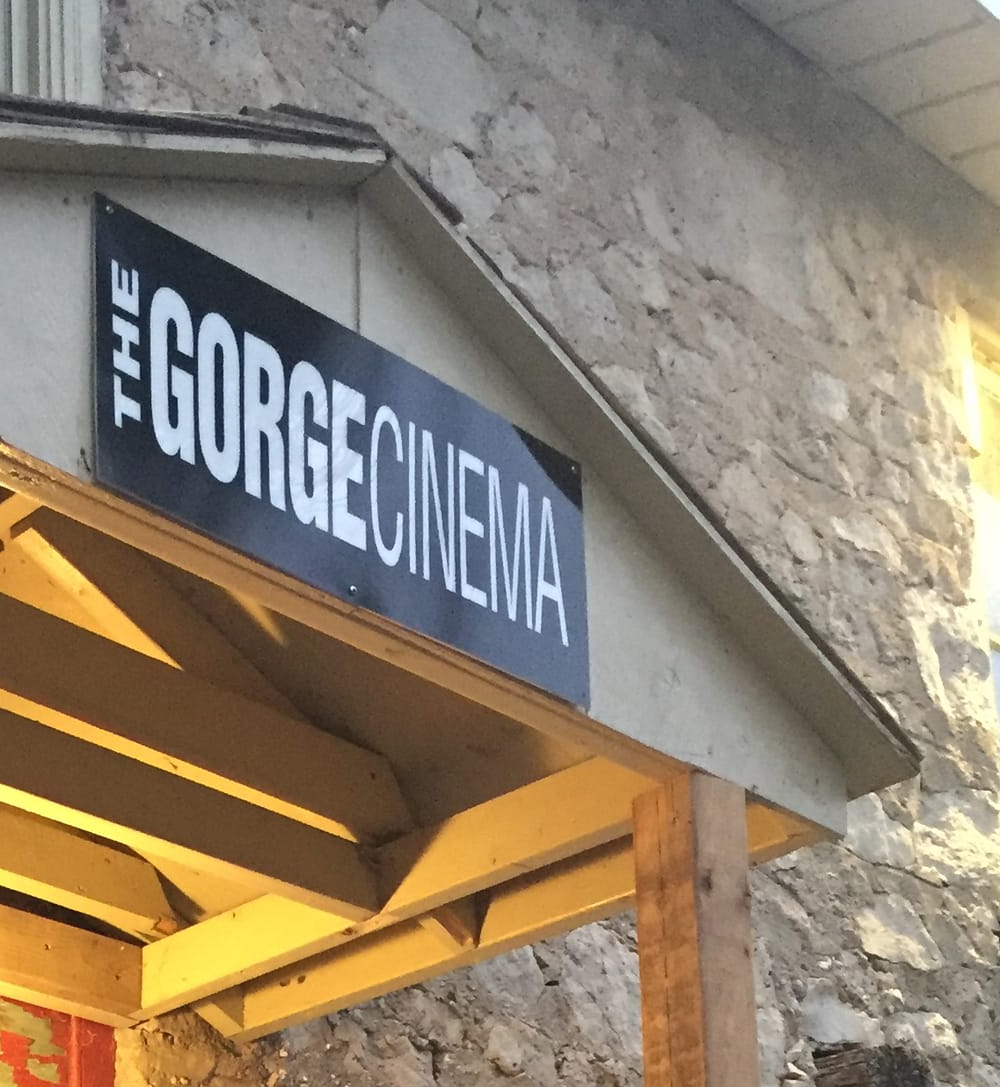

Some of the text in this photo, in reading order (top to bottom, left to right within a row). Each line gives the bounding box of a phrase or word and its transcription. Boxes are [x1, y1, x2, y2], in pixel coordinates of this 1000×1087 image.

[111, 259, 142, 428] THE
[149, 286, 569, 647] GORGE CINEMA
